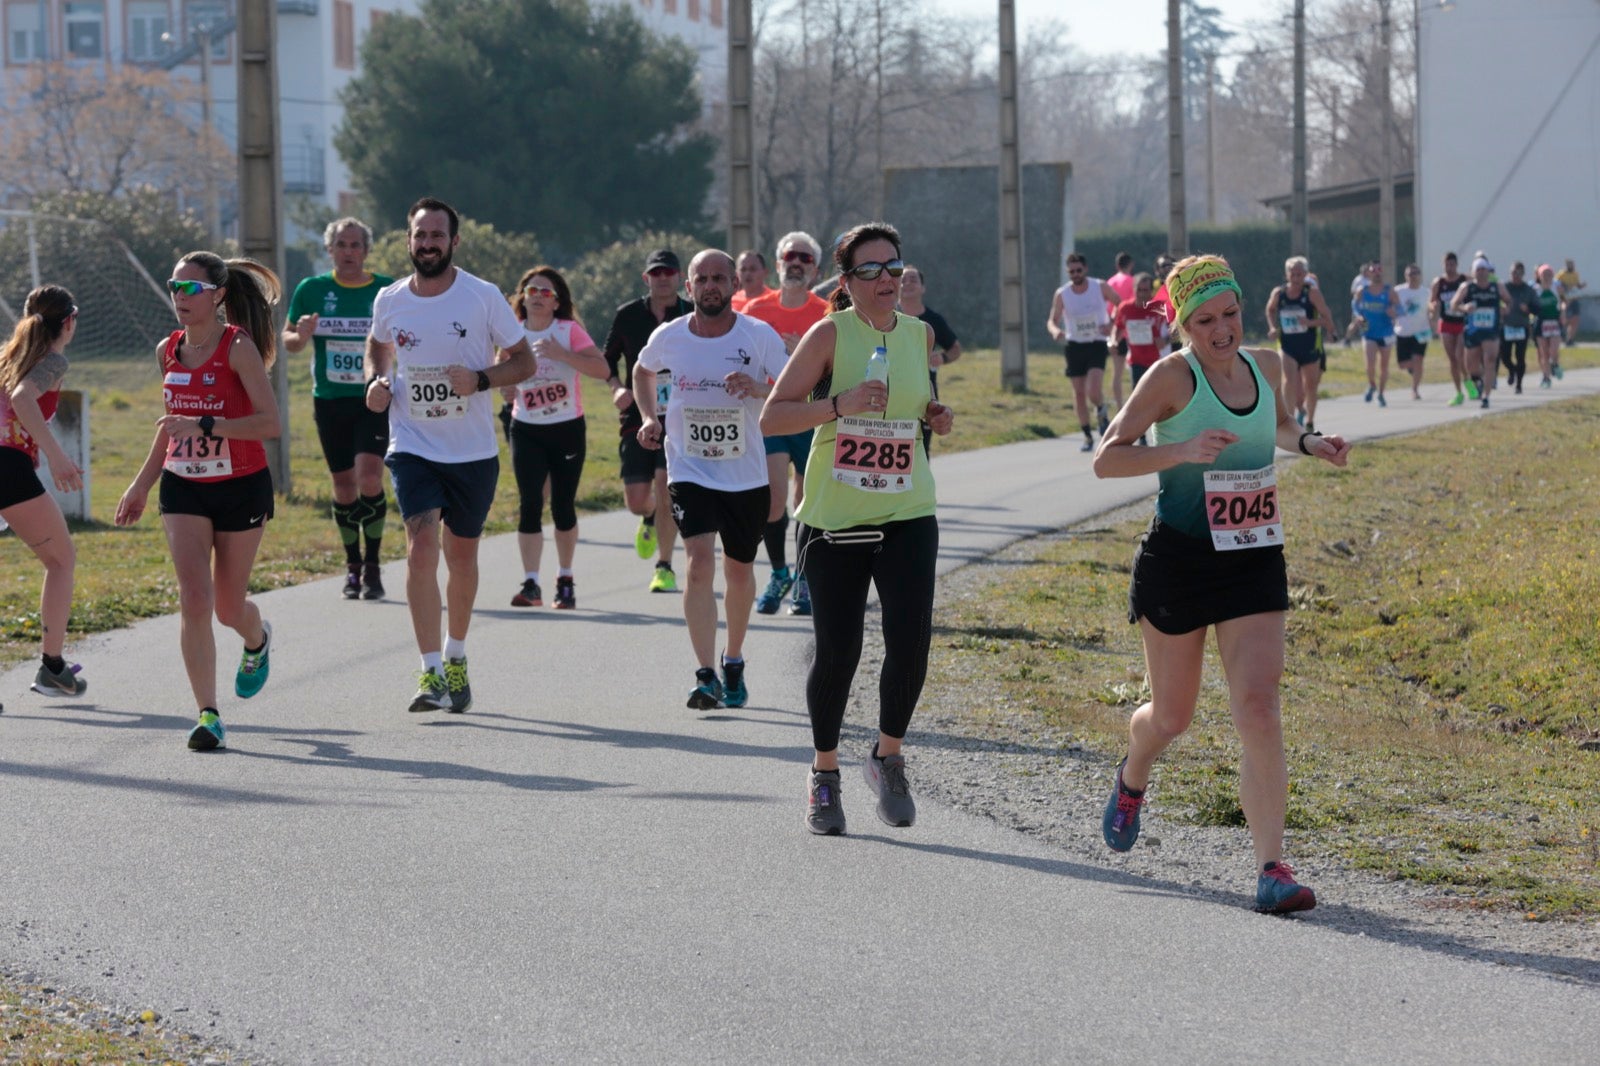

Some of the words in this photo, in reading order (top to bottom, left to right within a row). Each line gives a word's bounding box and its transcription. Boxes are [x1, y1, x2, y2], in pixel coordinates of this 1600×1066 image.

[319, 320, 343, 328] CAJA
[333, 354, 363, 370] 690
[525, 384, 567, 407] 2169
[690, 423, 739, 443] 3093
[858, 419, 873, 427] GRAN
[873, 420, 891, 429] PREMIO
[892, 422, 898, 430] DE
[899, 422, 914, 430] FONDO
[171, 436, 224, 458] 2137
[839, 439, 910, 470] 2285
[1226, 473, 1242, 481] GRAN
[1210, 491, 1275, 525] 2045
